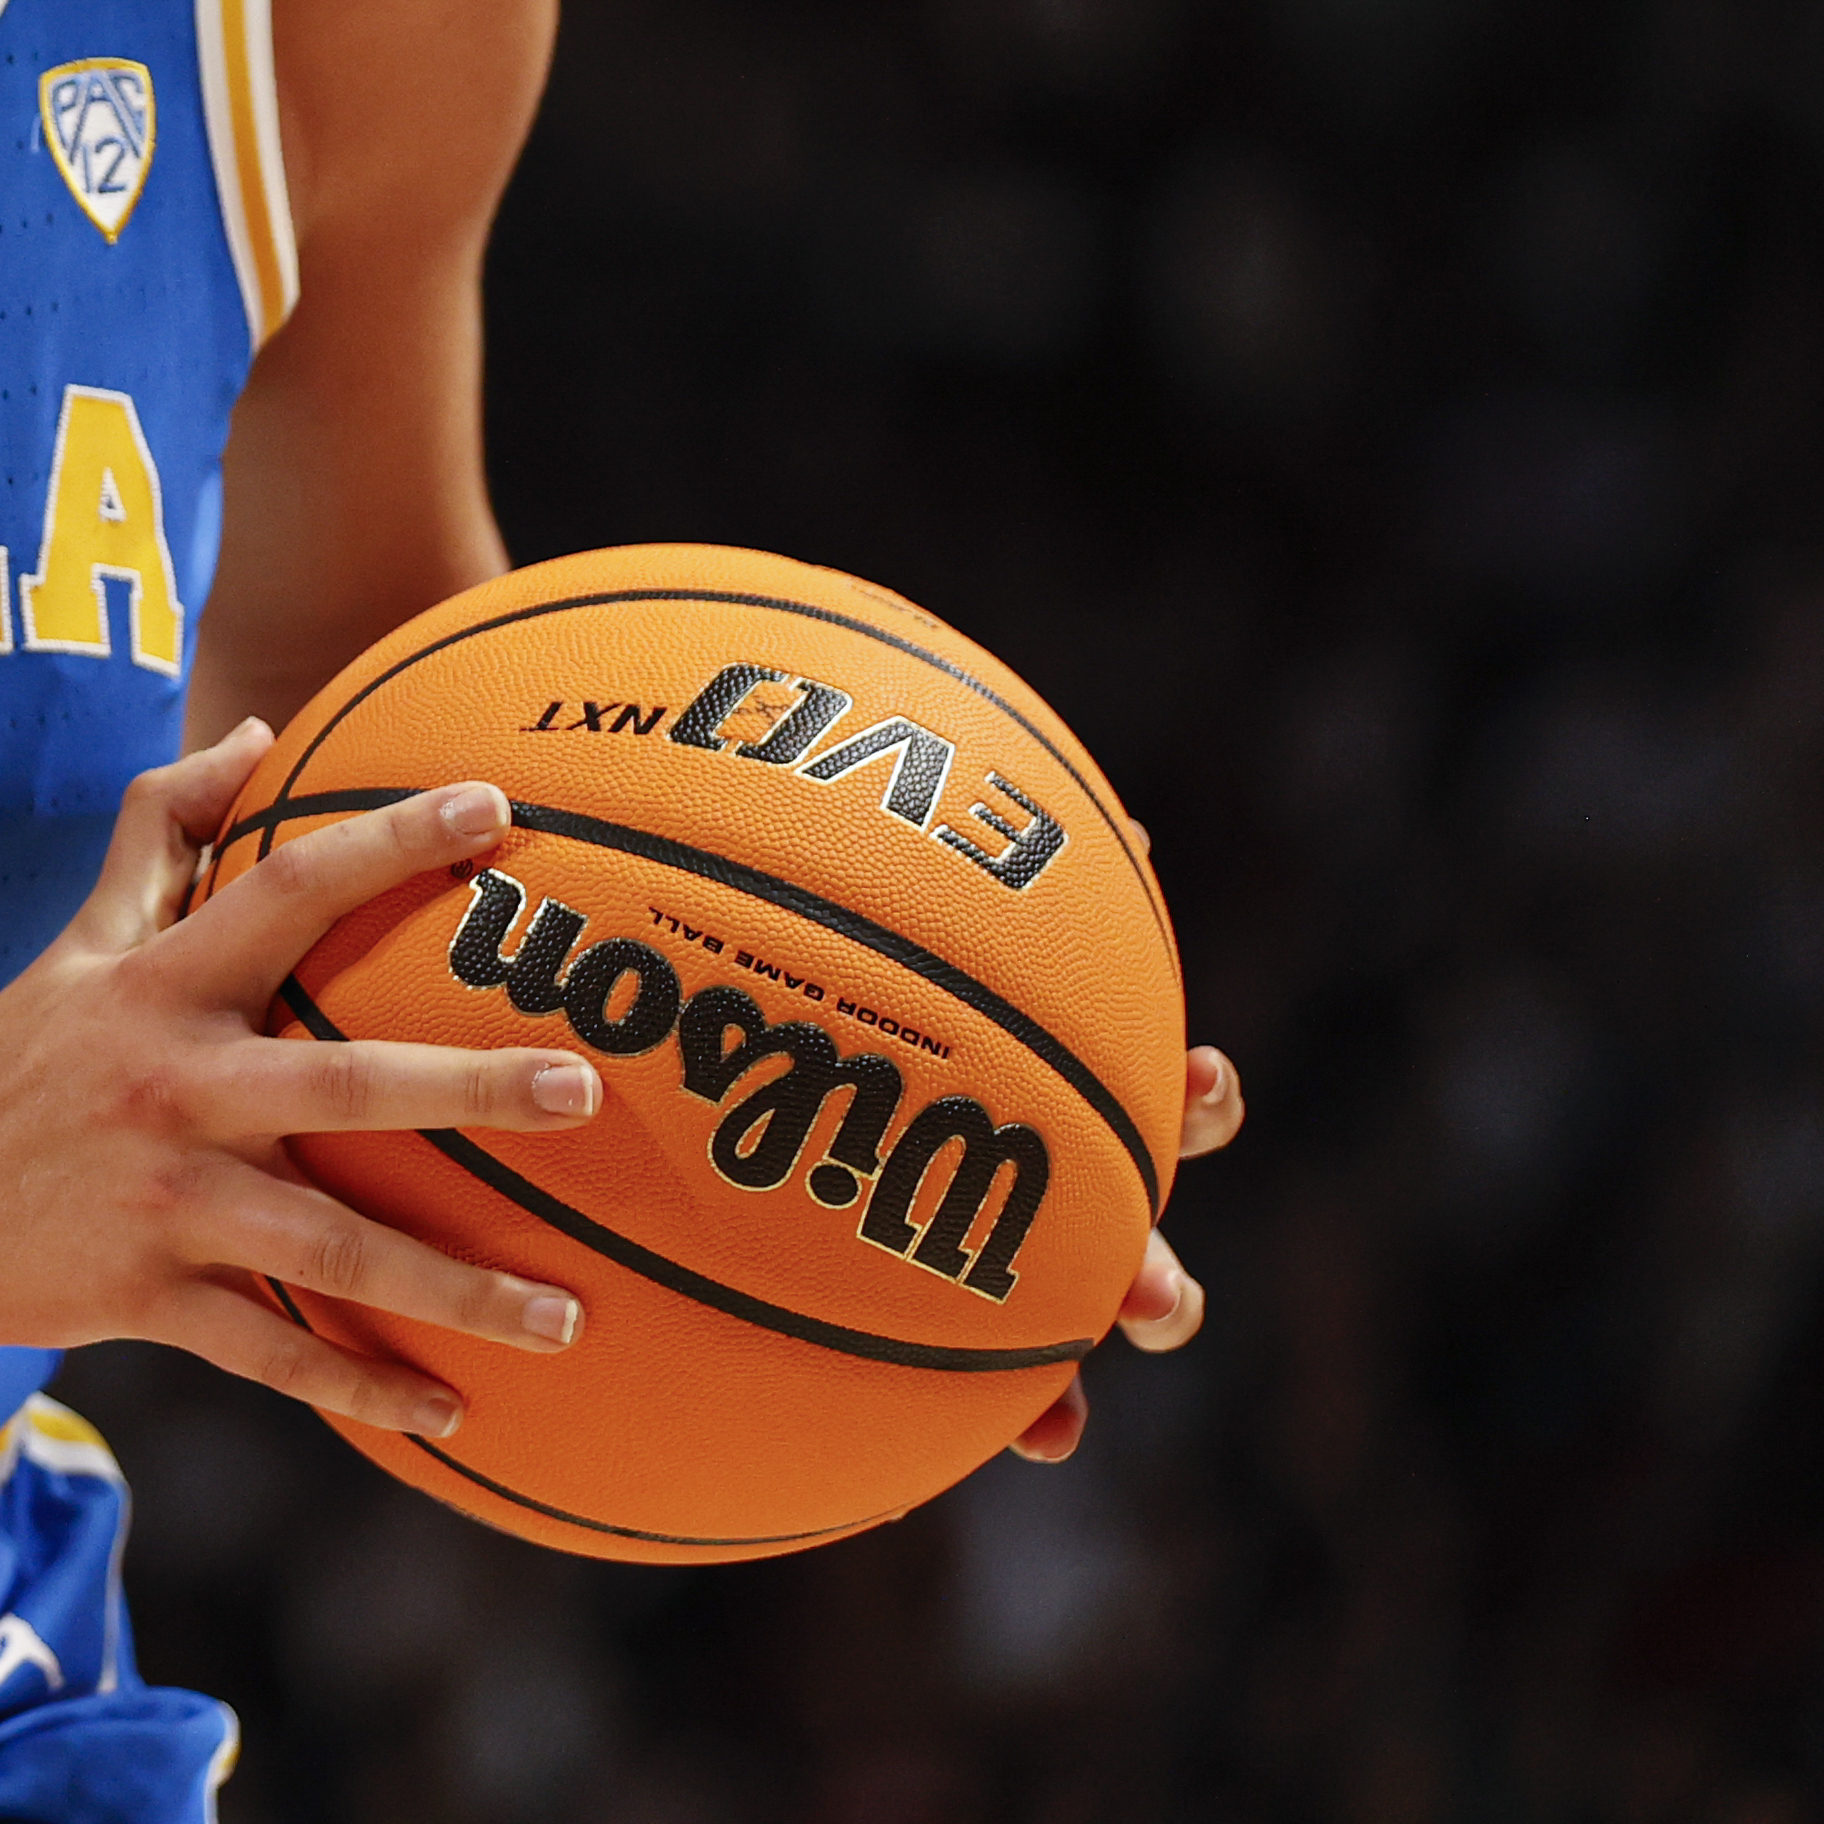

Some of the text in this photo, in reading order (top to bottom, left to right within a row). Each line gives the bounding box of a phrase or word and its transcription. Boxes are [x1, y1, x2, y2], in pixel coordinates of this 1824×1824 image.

[52, 69, 147, 164] PAC
[80, 137, 128, 194] 12
[520, 661, 1069, 892] EVO NXT
[648, 906, 950, 1061] INDOOR GAME BALL
[449, 867, 1051, 1304] Wilson
